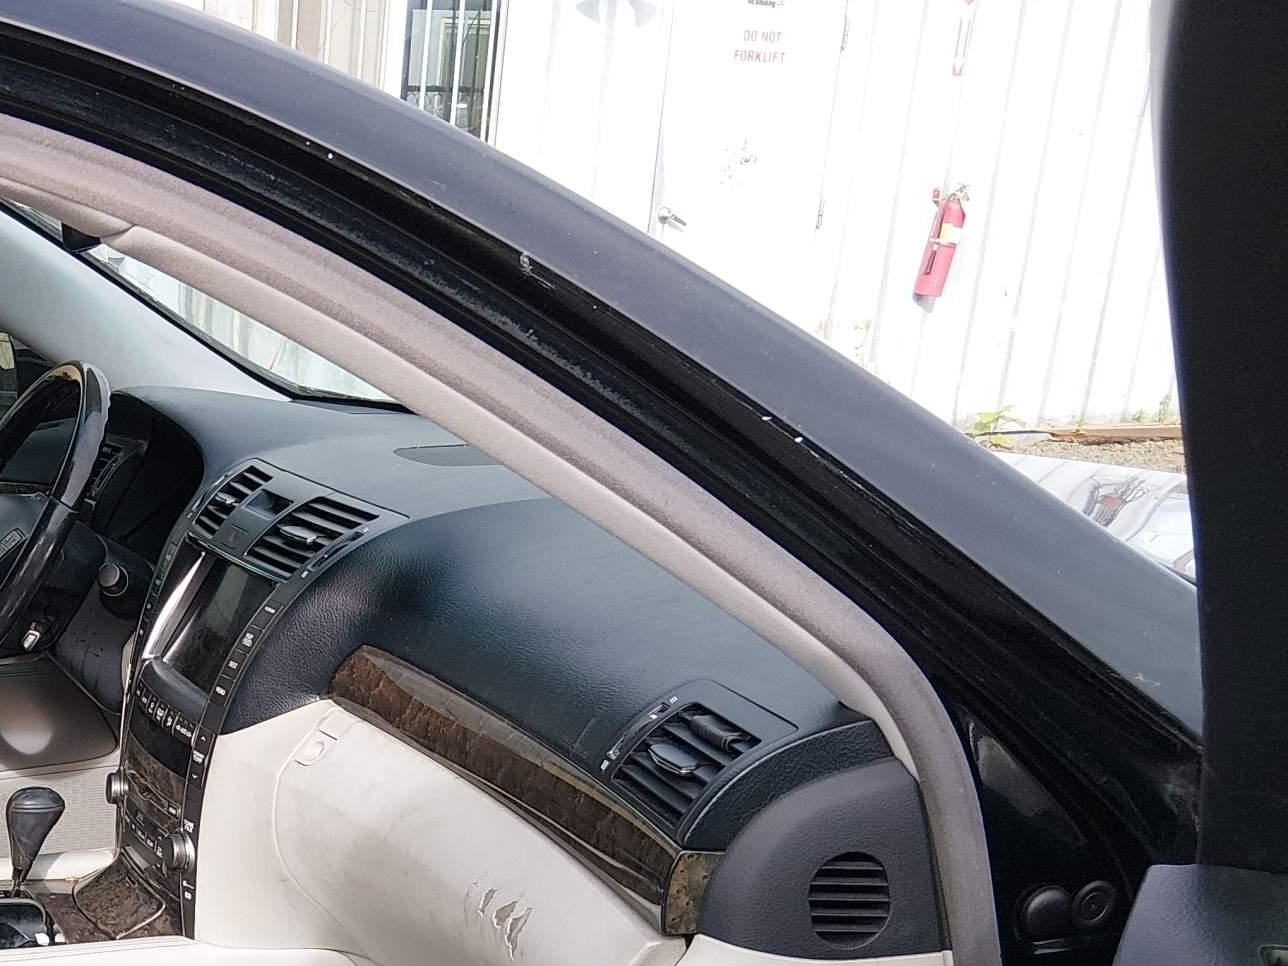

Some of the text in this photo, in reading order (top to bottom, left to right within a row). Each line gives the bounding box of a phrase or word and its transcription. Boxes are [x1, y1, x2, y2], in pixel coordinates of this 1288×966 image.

[743, 29, 782, 44] DO NOT
[734, 49, 786, 64] FORKLIFT
